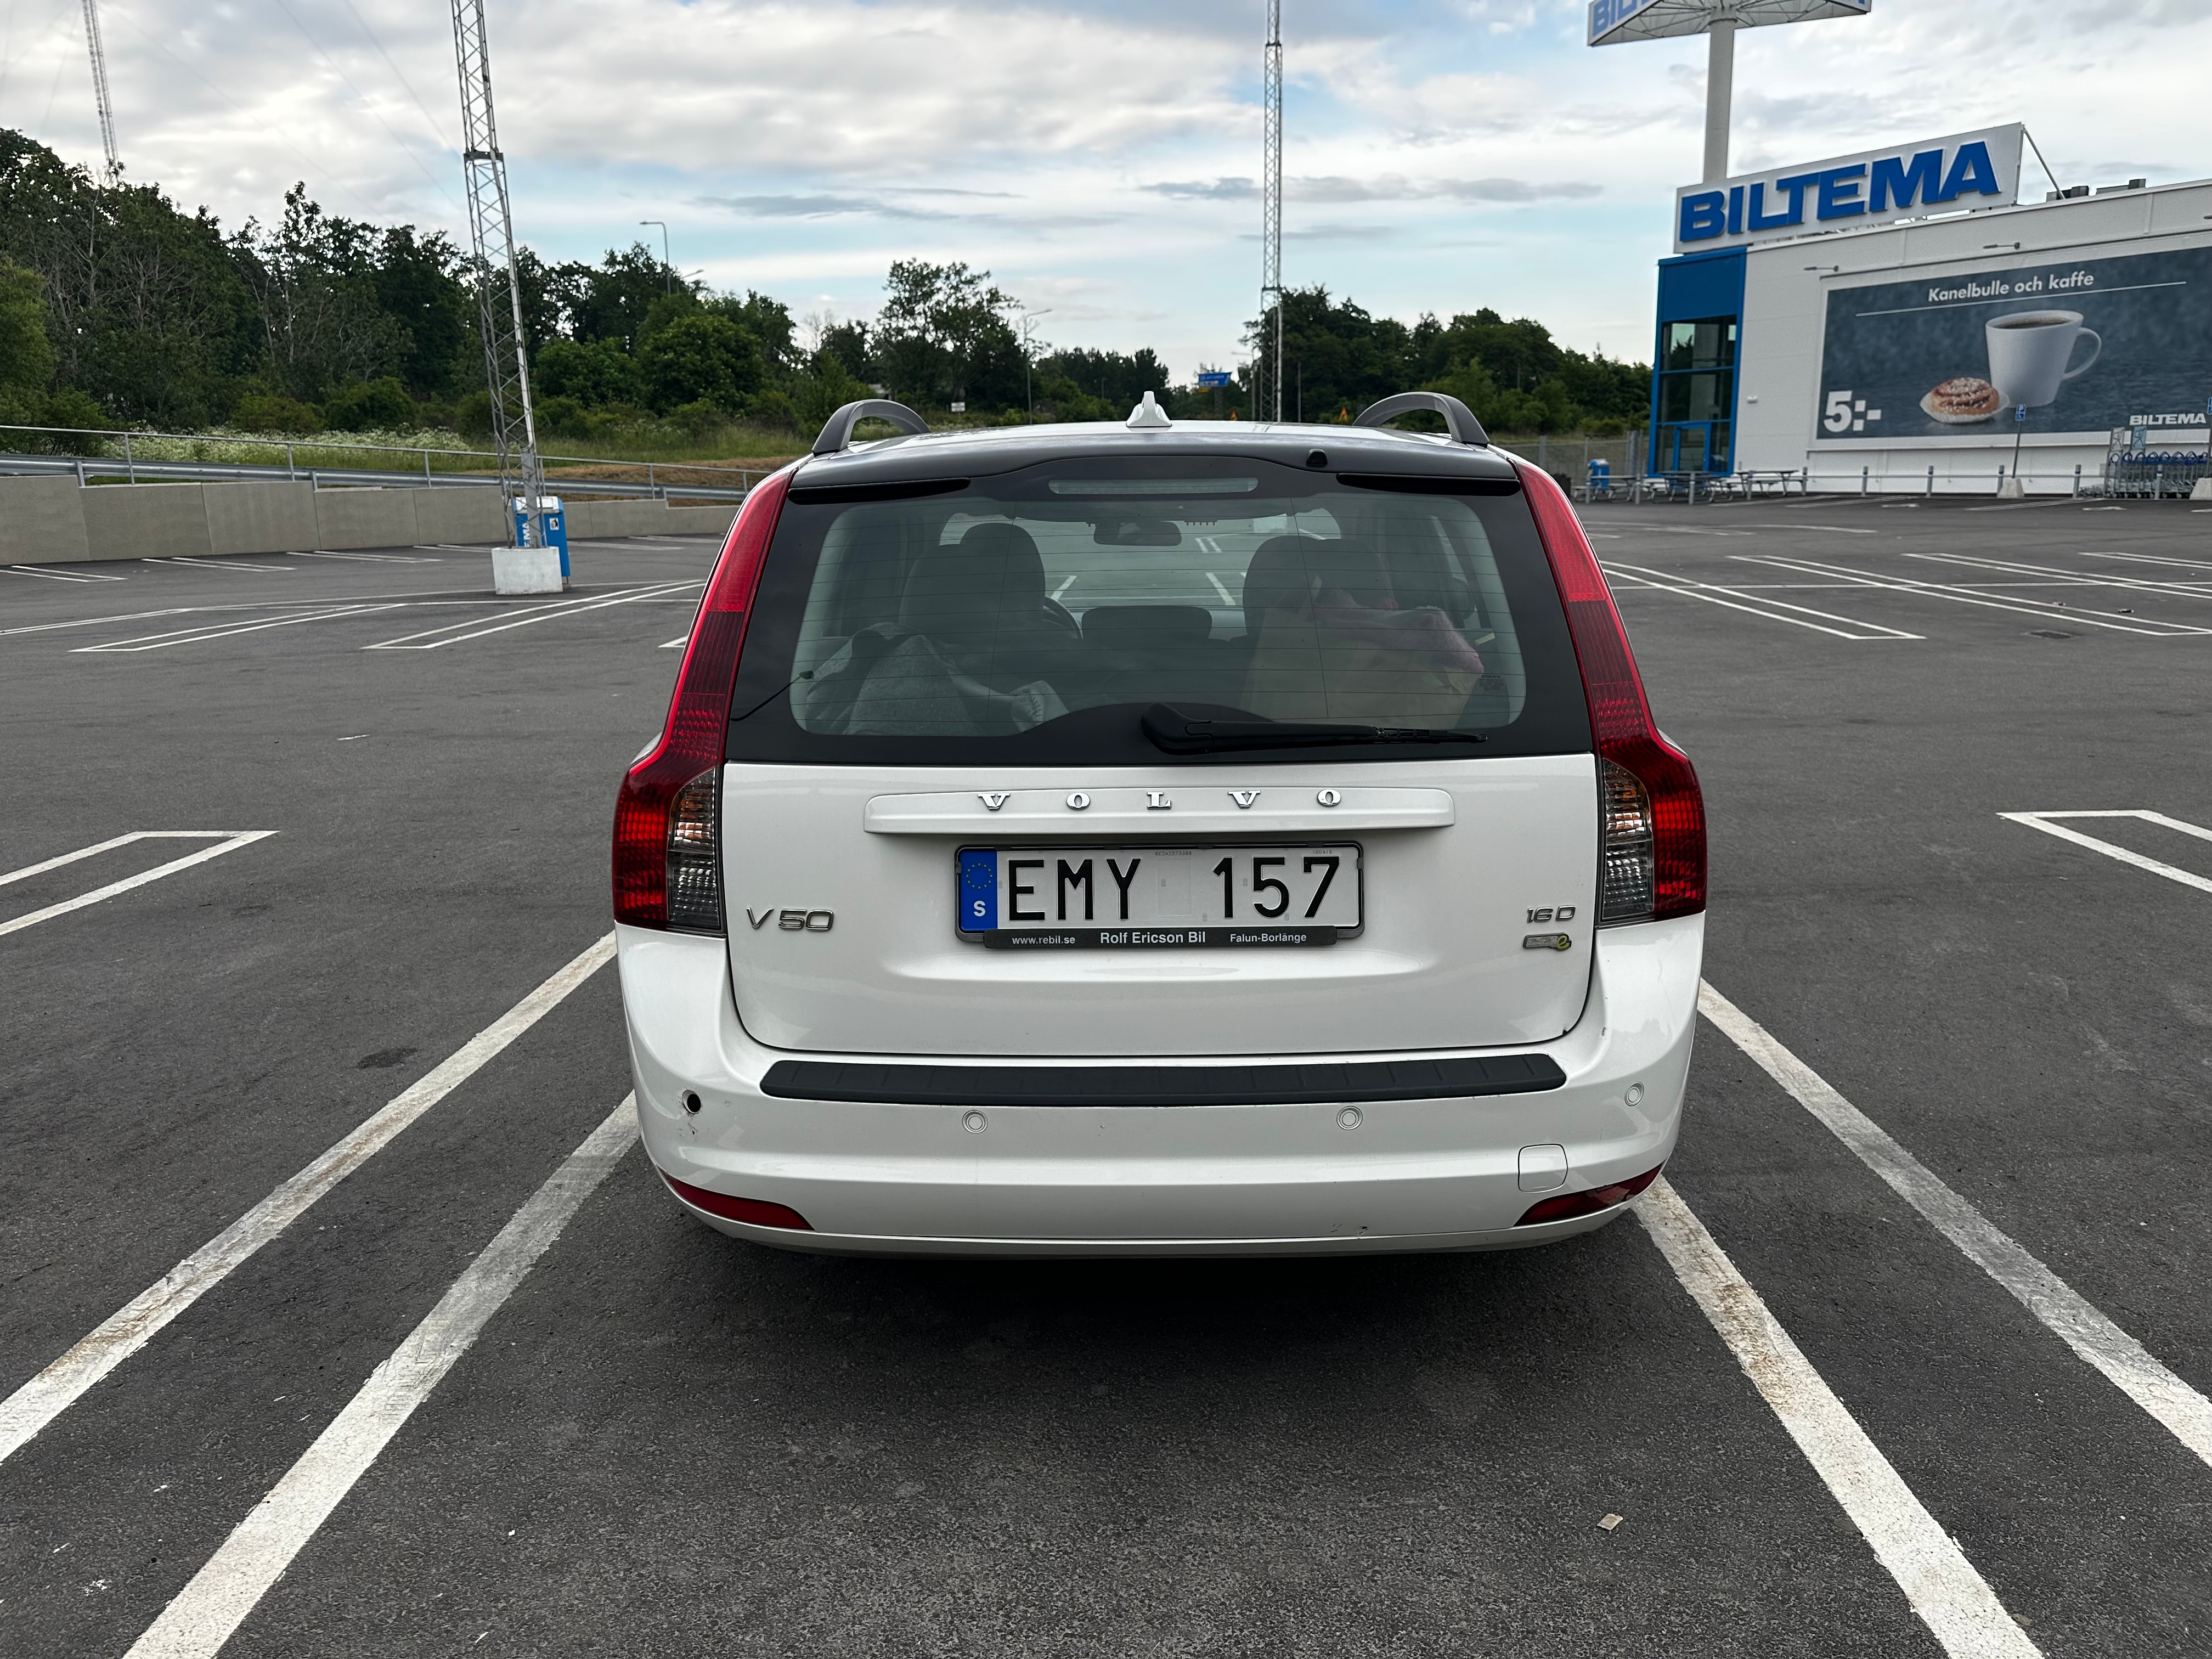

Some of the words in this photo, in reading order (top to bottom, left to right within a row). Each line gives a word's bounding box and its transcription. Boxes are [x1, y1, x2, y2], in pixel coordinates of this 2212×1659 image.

[1679, 141, 2002, 242] BILTEMA
[1928, 280, 2009, 302] Kanelbulle
[2014, 276, 2042, 293] och
[2049, 270, 2094, 290] kaffe
[1823, 390, 1882, 433] 5:-
[2129, 413, 2207, 426] BILTEMA
[978, 789, 1342, 811] VOLVO
[1008, 858, 1141, 921] EMY
[1213, 856, 1340, 918] 157
[746, 907, 834, 932] V50
[973, 900, 986, 917] S
[1012, 935, 1076, 945] www.rebil.se
[1100, 932, 1128, 944] Rolf
[1132, 932, 1184, 944] Ericson
[1188, 931, 1206, 943] Bil
[1230, 933, 1307, 944] Falun-Borlänge
